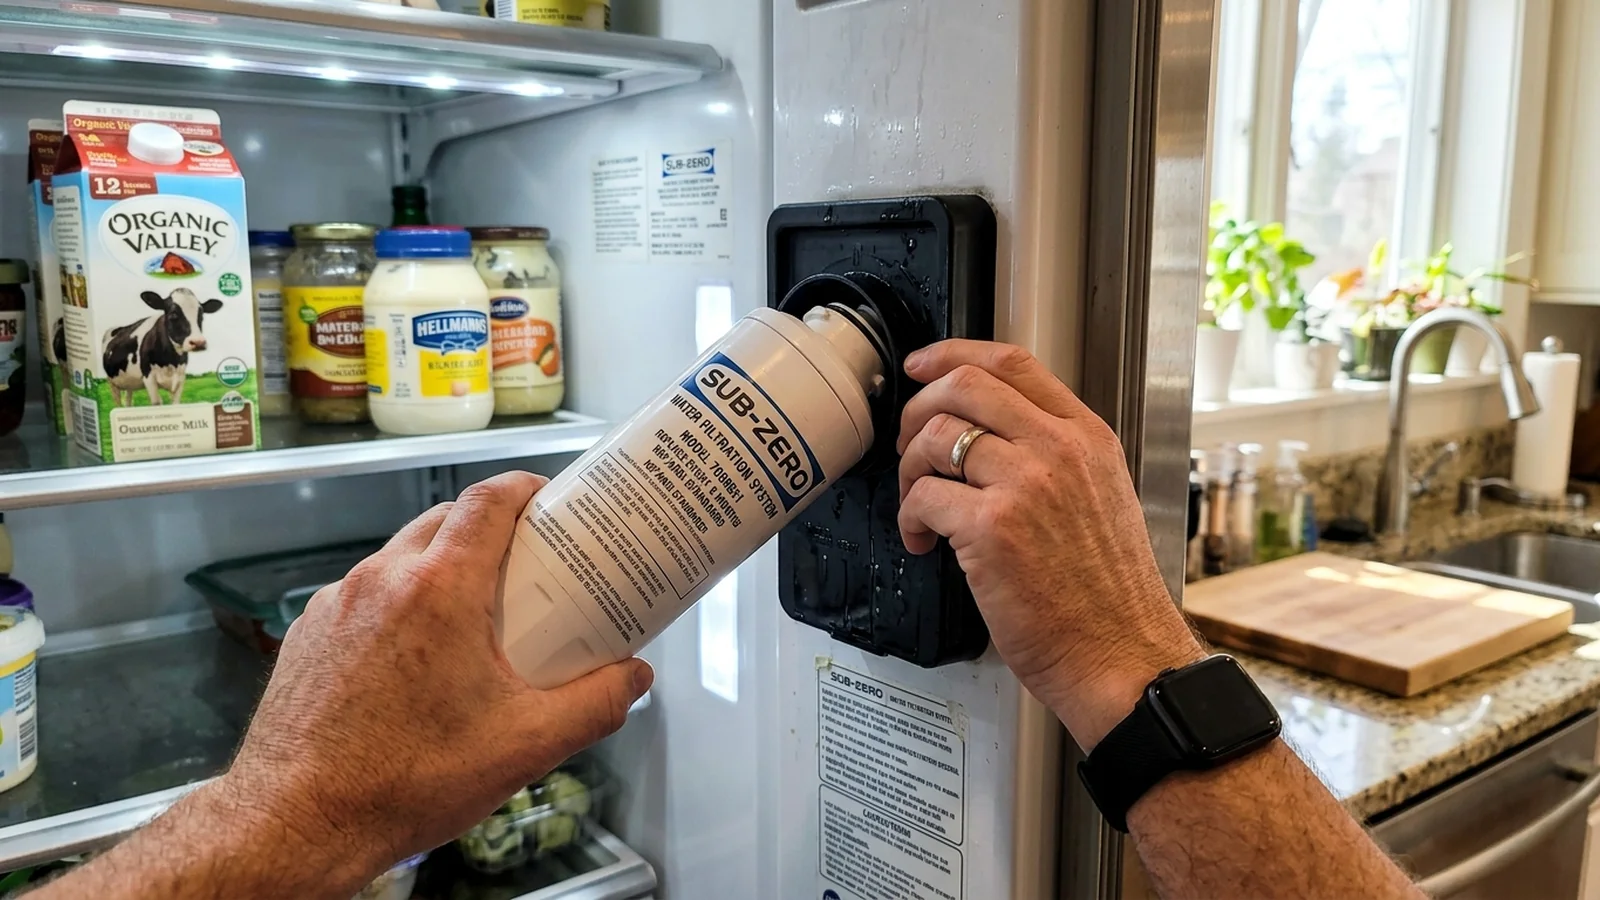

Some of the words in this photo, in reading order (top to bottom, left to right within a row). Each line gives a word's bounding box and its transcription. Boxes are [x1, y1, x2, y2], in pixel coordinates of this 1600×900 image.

[94, 177, 121, 195] 12
[108, 210, 229, 238] ORGANIC
[122, 232, 218, 256] VALLEY
[182, 419, 209, 430] Milk
[701, 367, 811, 491] SUB-ZERO
[679, 429, 711, 465] MODEL
